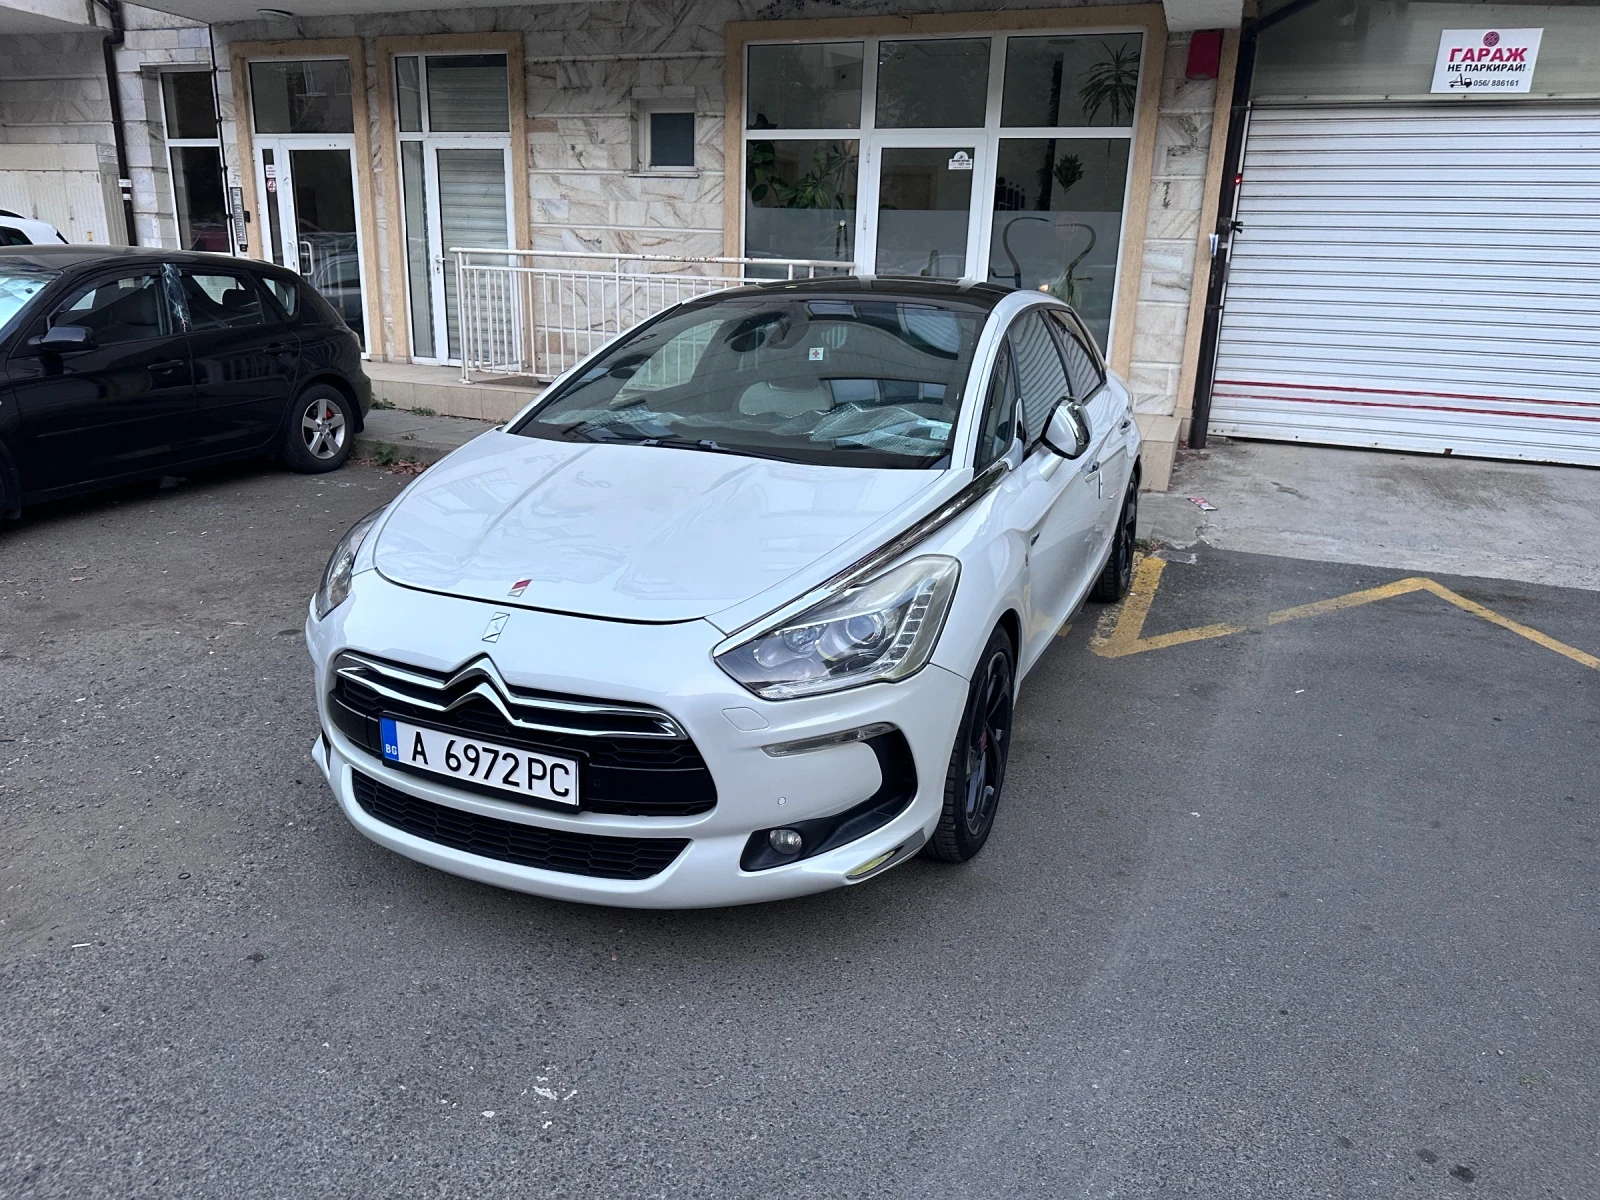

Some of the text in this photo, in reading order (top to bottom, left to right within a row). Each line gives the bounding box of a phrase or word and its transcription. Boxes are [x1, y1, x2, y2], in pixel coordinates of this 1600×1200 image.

[1448, 47, 1528, 62] ГАРАЖ
[1447, 62, 1526, 72] НЕ ПАРКИРАЙ!
[1491, 79, 1519, 87] 886161
[385, 744, 398, 756] BG
[411, 731, 429, 765] A
